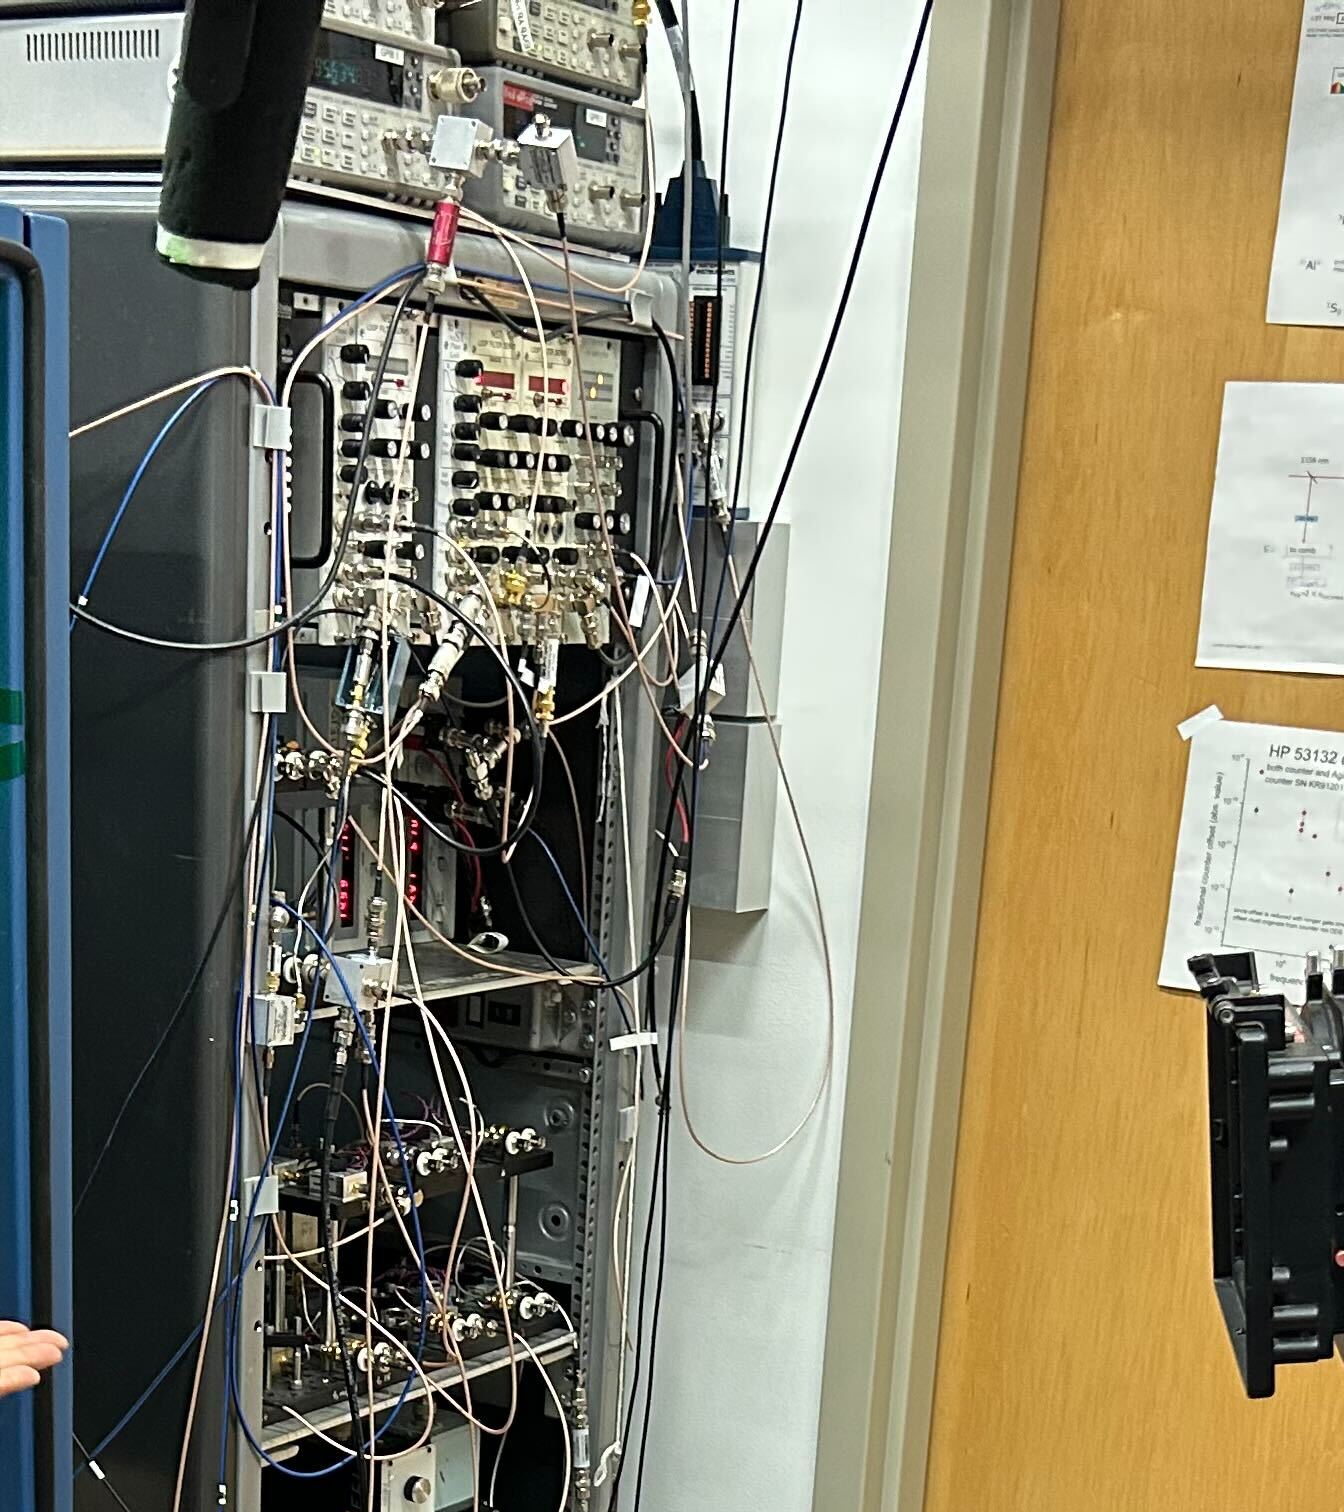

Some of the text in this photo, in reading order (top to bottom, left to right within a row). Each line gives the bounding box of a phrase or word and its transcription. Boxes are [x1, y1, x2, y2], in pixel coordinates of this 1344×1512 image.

[1269, 743, 1291, 759] HP
[1294, 747, 1338, 765] 53132
[1285, 766, 1314, 776] counter
[1315, 769, 1330, 778] and
[1206, 825, 1216, 850] offset
[1202, 851, 1212, 885] counter
[1194, 886, 1207, 926] fractional
[1270, 973, 1304, 986] frequenc
